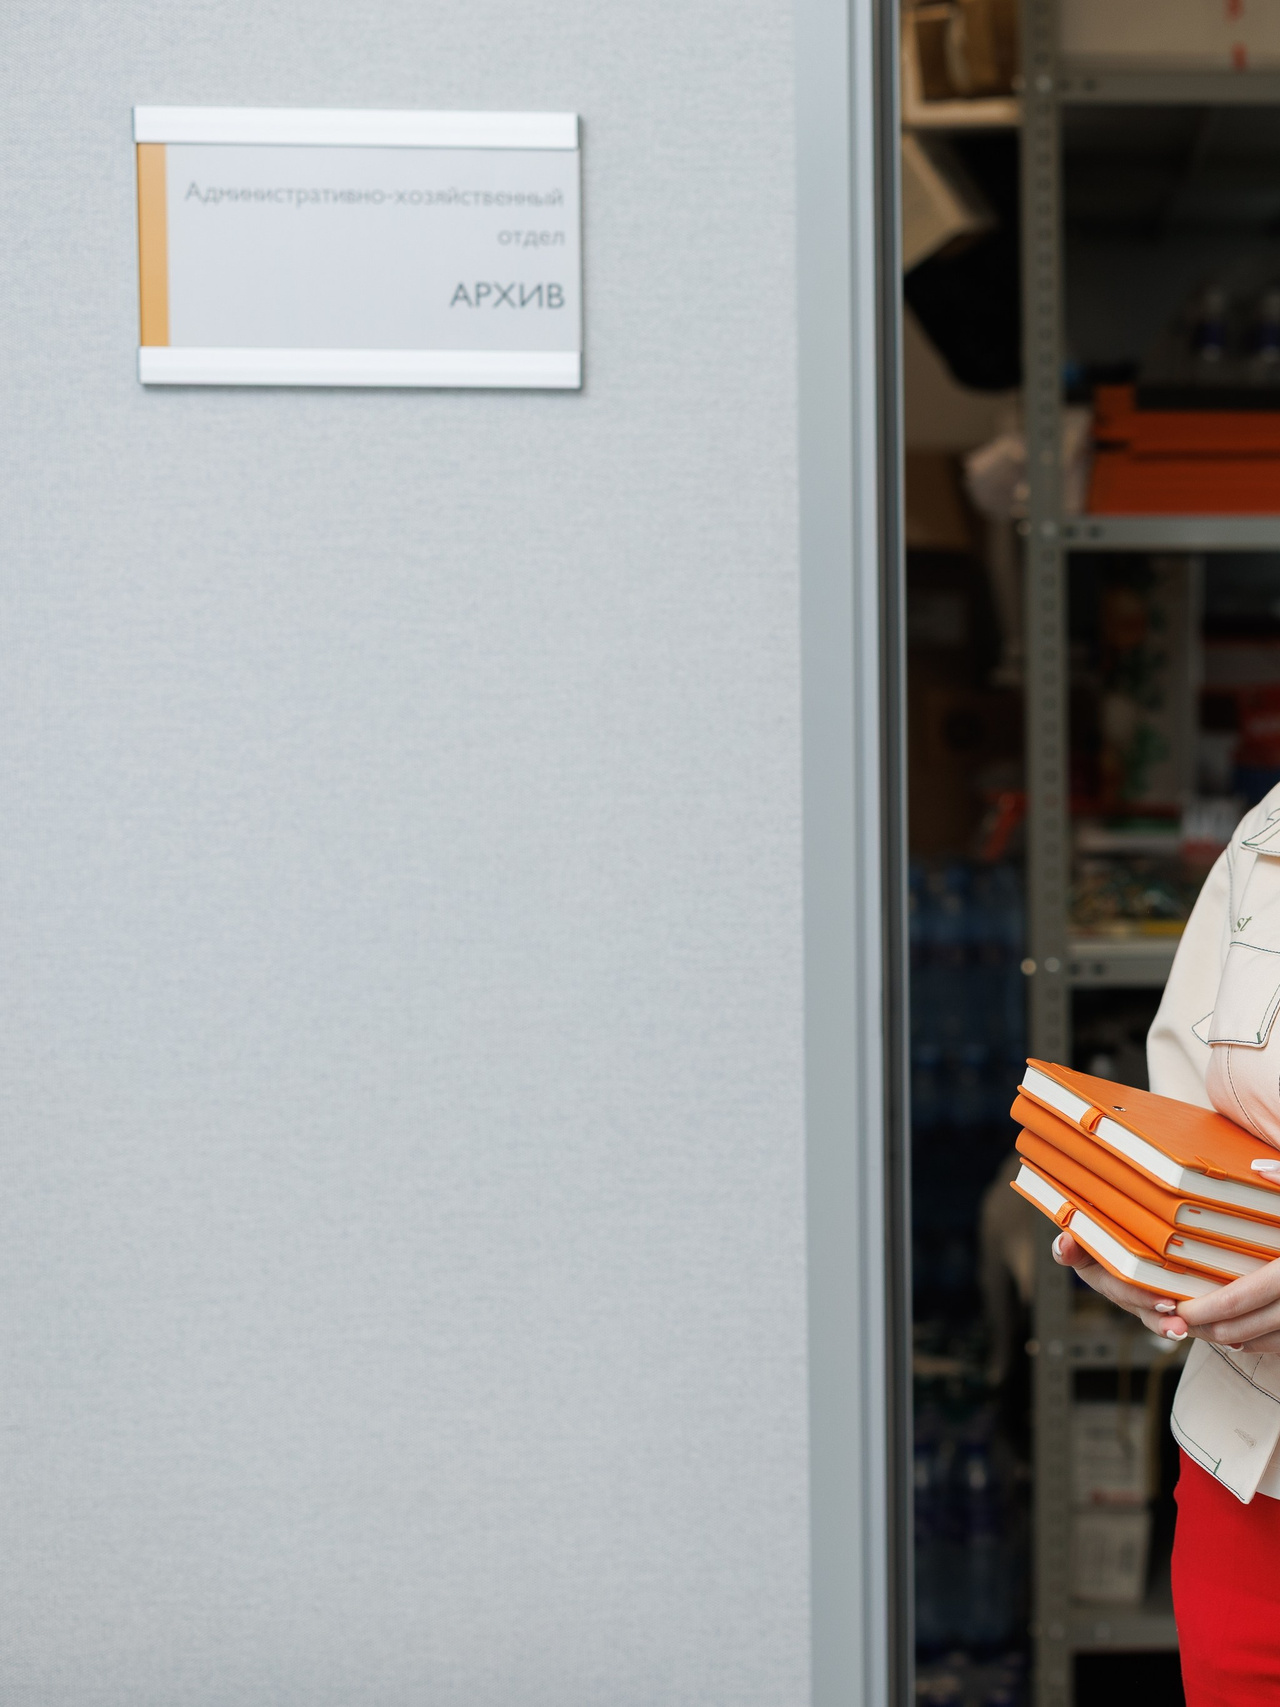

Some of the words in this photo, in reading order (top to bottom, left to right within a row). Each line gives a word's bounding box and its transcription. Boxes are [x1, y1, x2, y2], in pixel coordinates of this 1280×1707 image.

[184, 181, 564, 208] Административно-хозяйственный
[497, 229, 565, 247] отдел
[449, 282, 565, 309] АРХИВ
